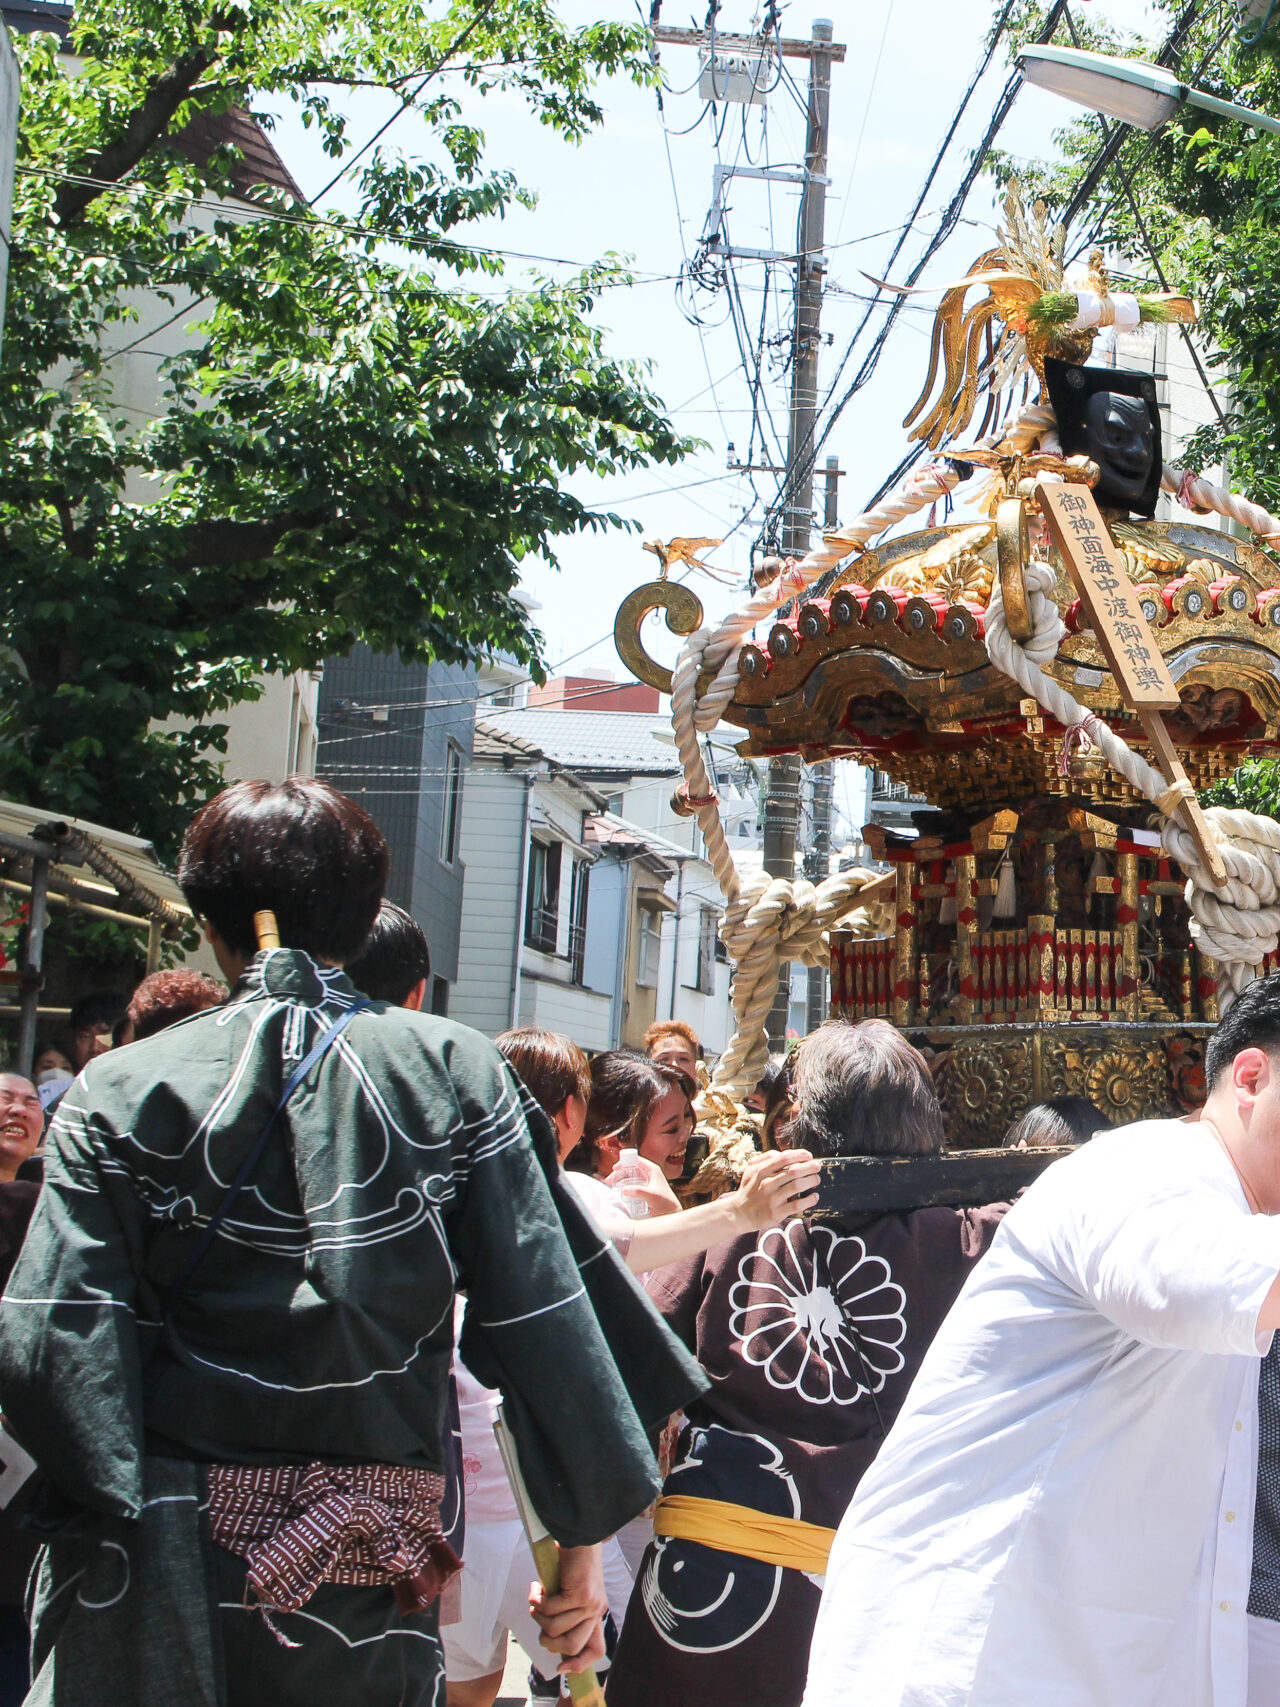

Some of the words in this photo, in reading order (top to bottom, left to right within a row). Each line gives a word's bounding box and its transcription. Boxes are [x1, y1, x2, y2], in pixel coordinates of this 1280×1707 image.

[1056, 491, 1164, 692] 御神面海中渡御神輿
